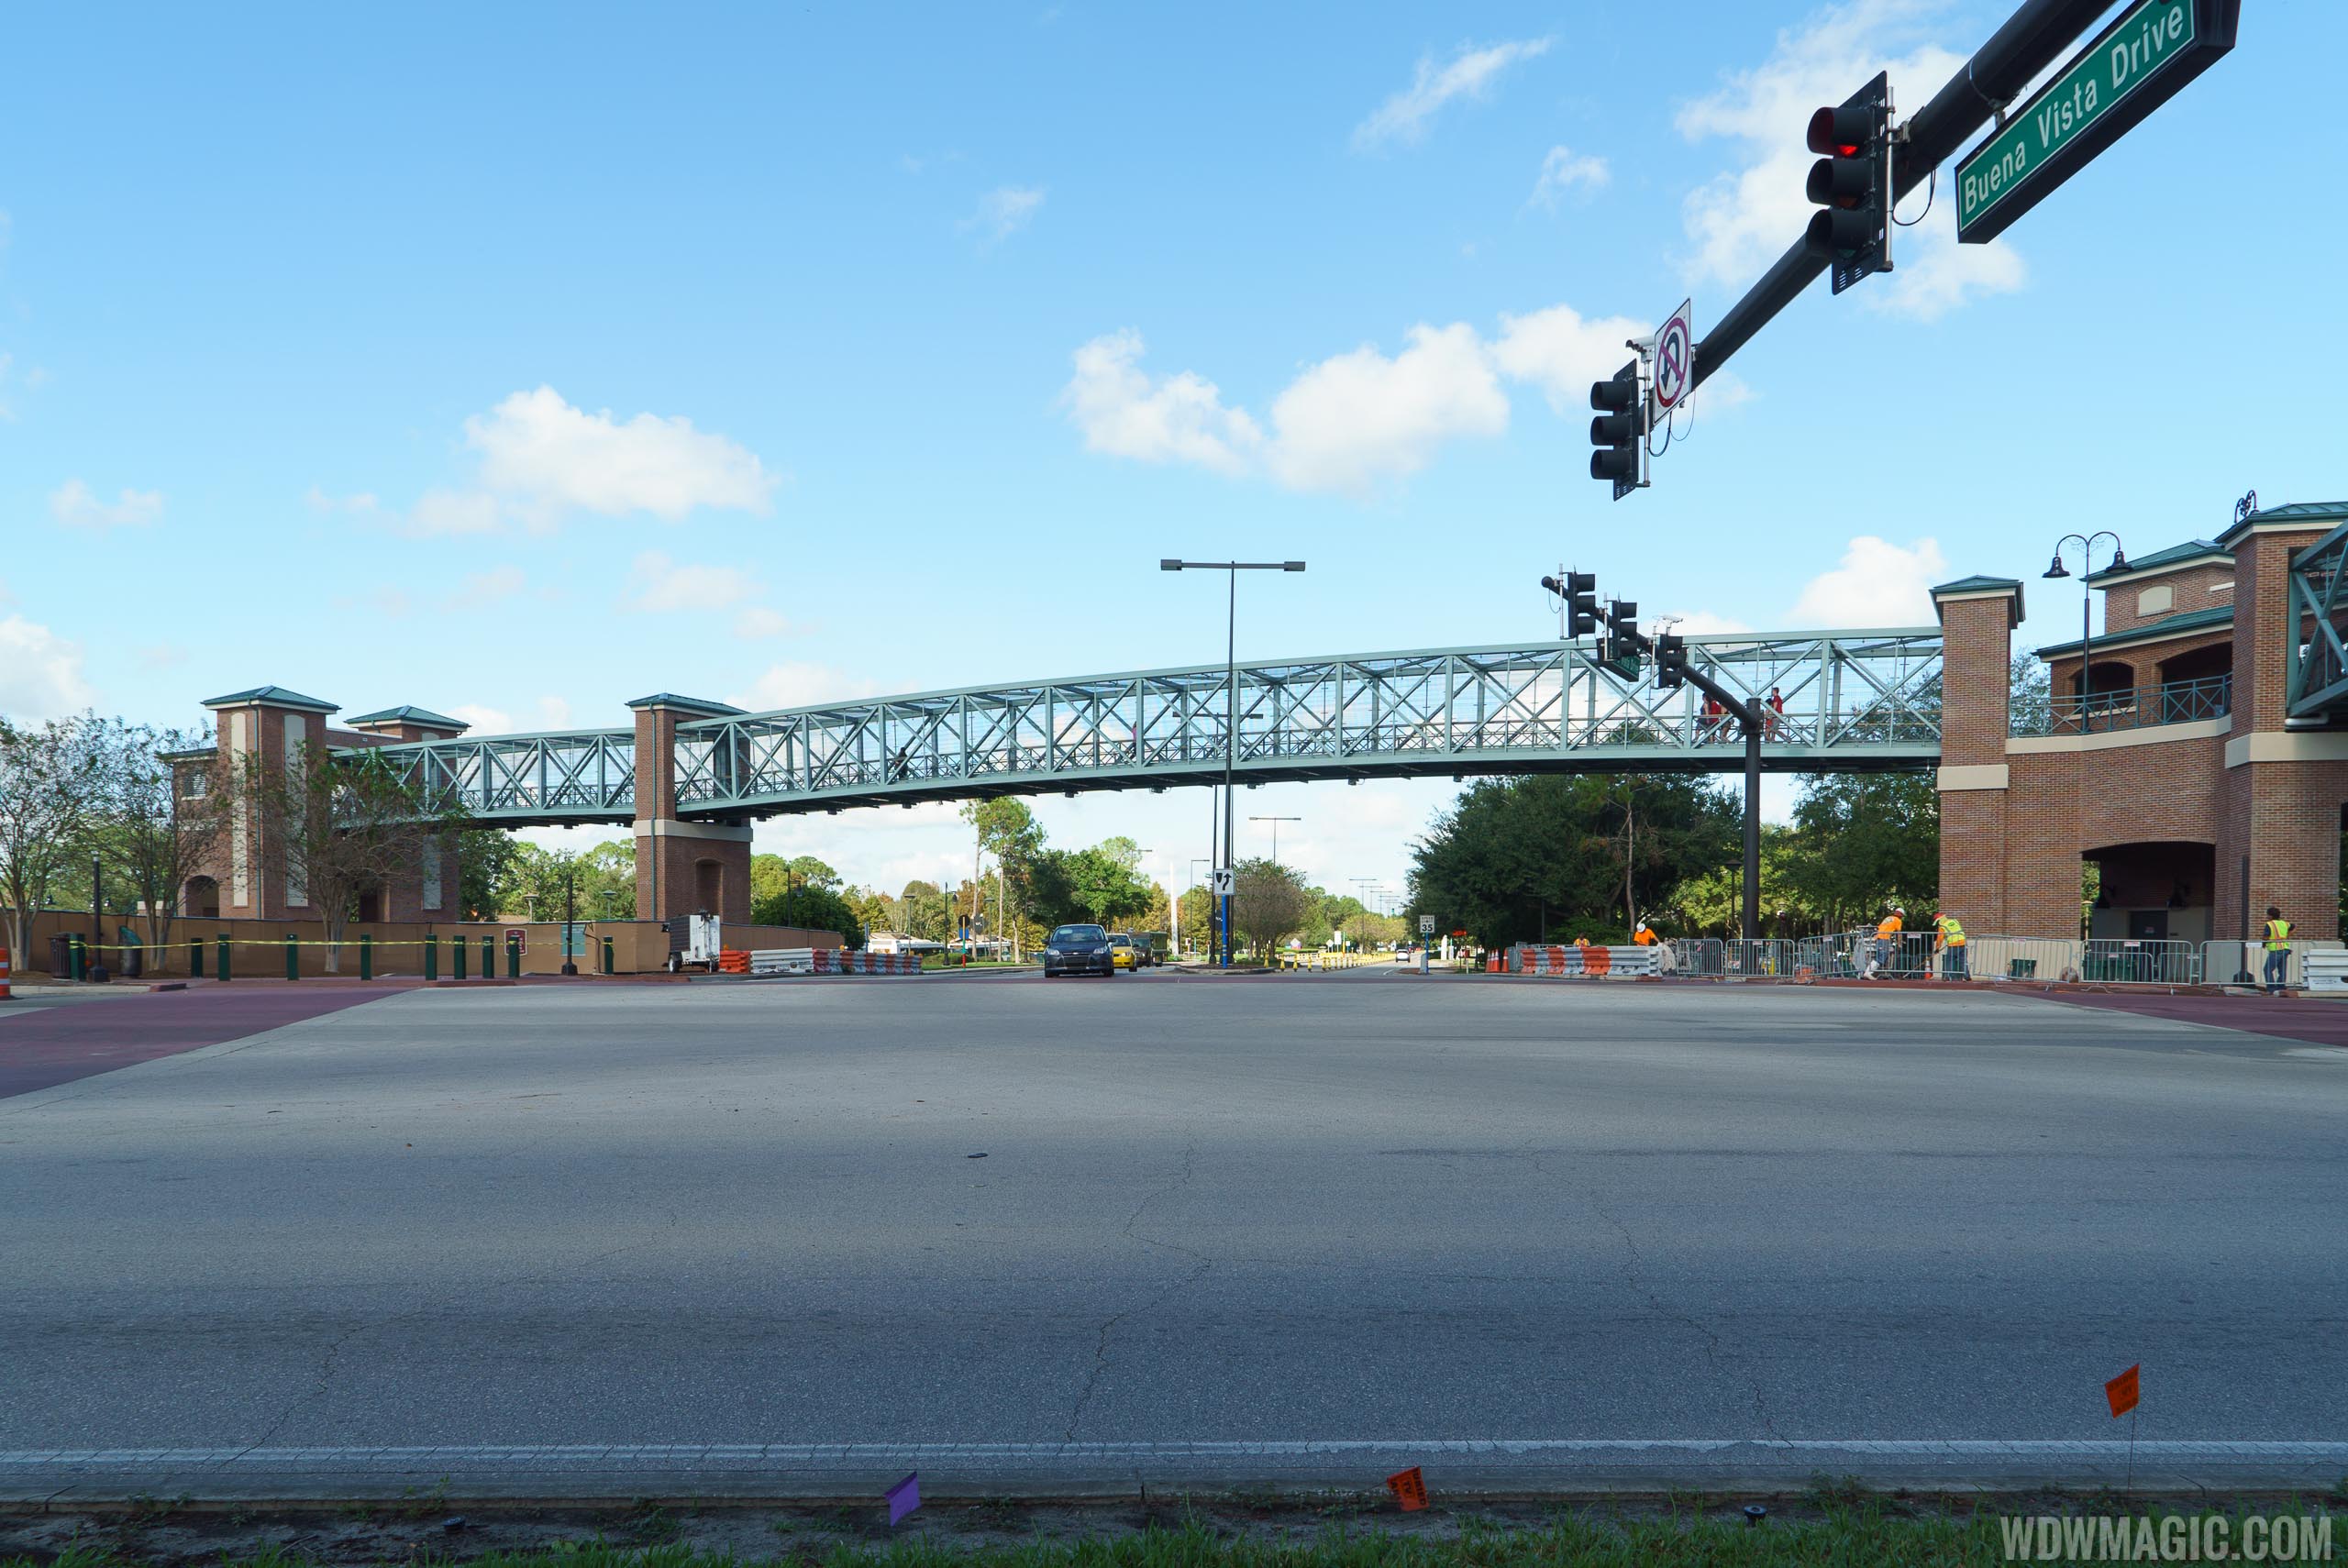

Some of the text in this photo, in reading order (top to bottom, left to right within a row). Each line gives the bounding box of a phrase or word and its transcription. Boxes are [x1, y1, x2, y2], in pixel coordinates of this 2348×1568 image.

[1964, 5, 2184, 215] Buena Vista Drive
[1422, 923, 1433, 932] 35
